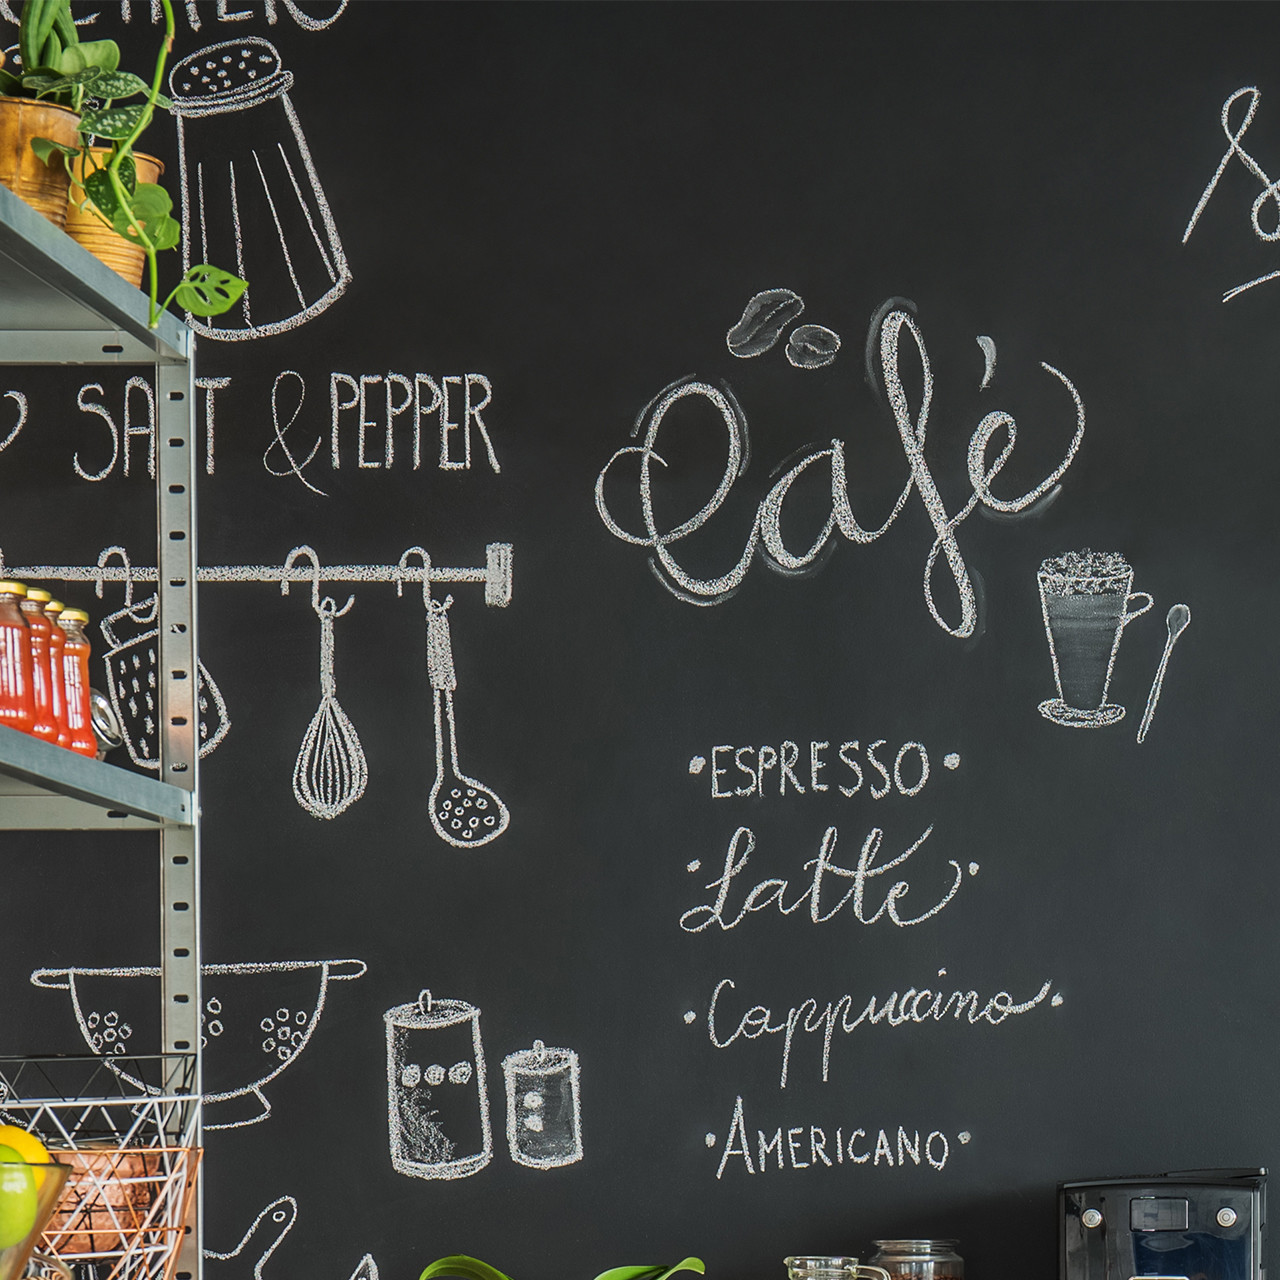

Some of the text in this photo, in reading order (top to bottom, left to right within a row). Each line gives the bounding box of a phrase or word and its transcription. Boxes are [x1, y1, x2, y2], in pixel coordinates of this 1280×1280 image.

[73, 374, 233, 482] SAT
[330, 371, 501, 474] PEPPER
[711, 739, 931, 800] ESPRESSO
[679, 823, 962, 933] Latte
